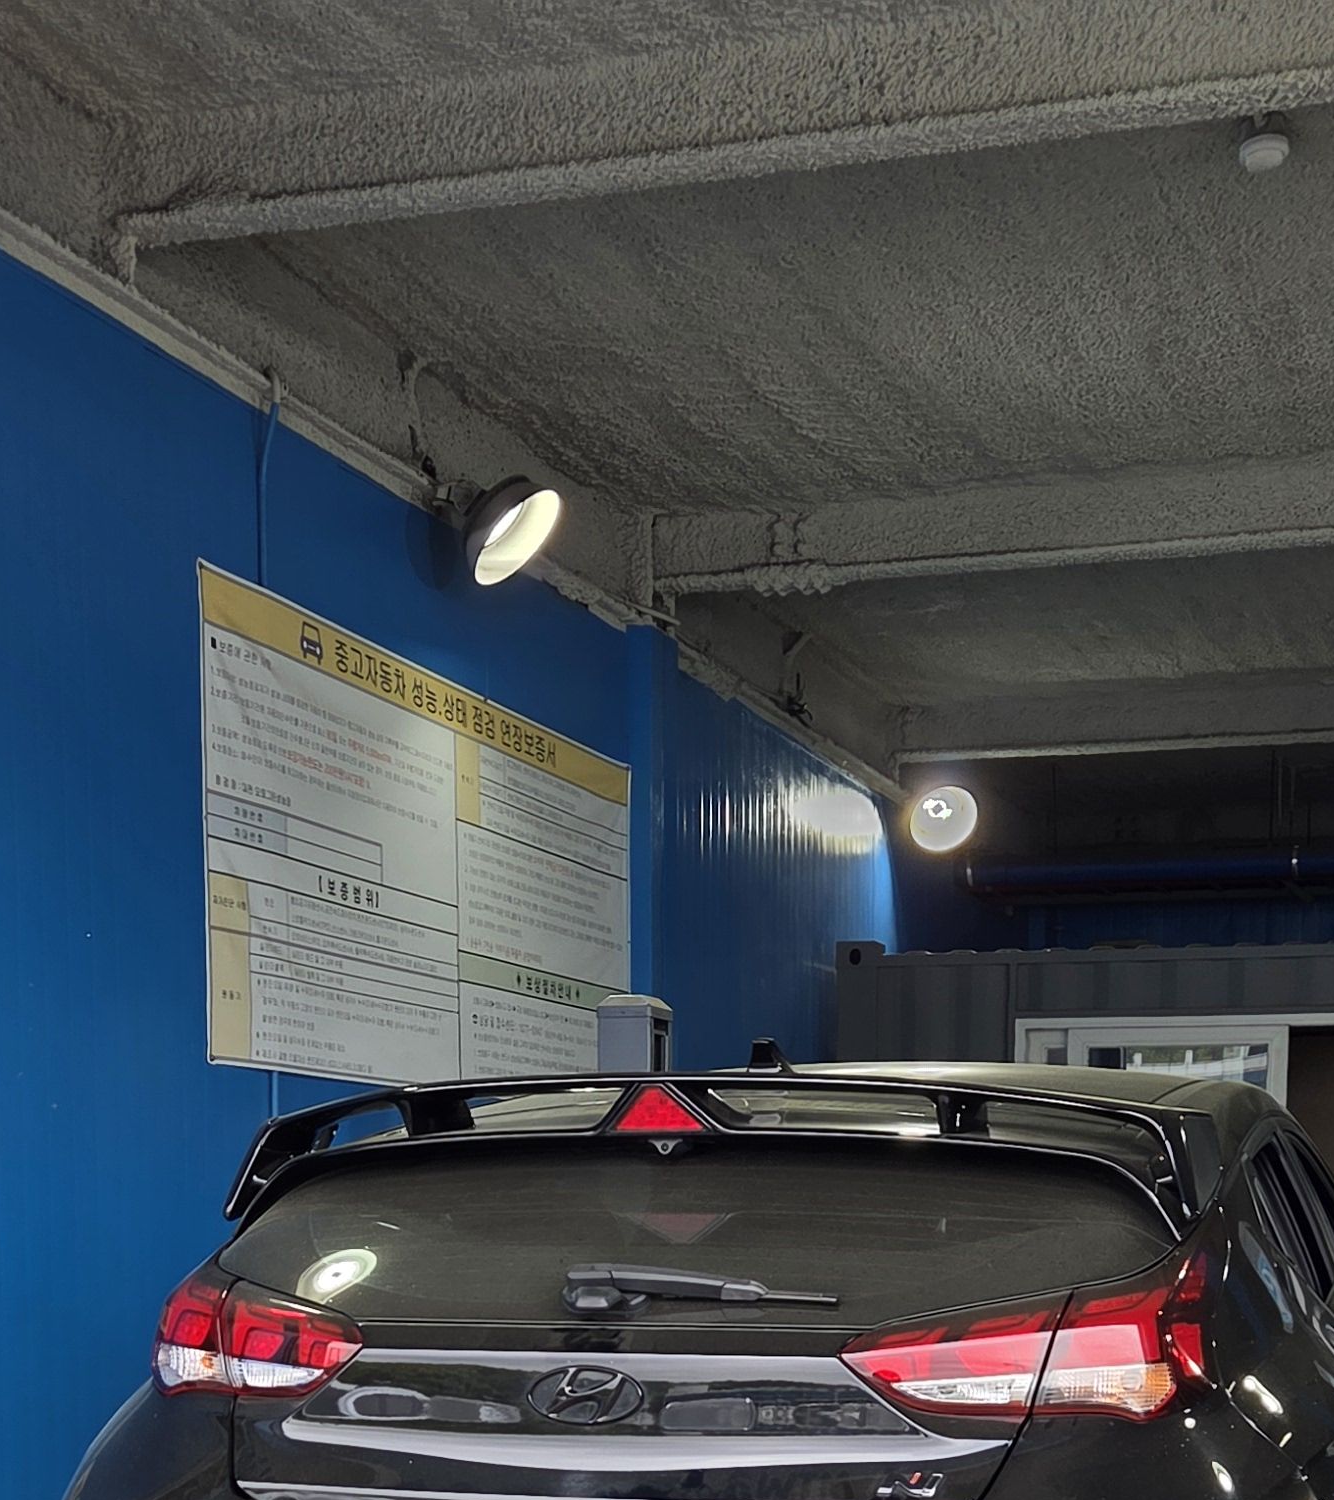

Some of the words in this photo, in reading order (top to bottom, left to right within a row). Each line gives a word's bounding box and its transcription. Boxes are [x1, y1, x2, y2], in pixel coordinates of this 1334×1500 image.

[335, 639, 406, 700] 중고자동차
[472, 705, 496, 741] 점검
[500, 719, 557, 769] 연장보증서
